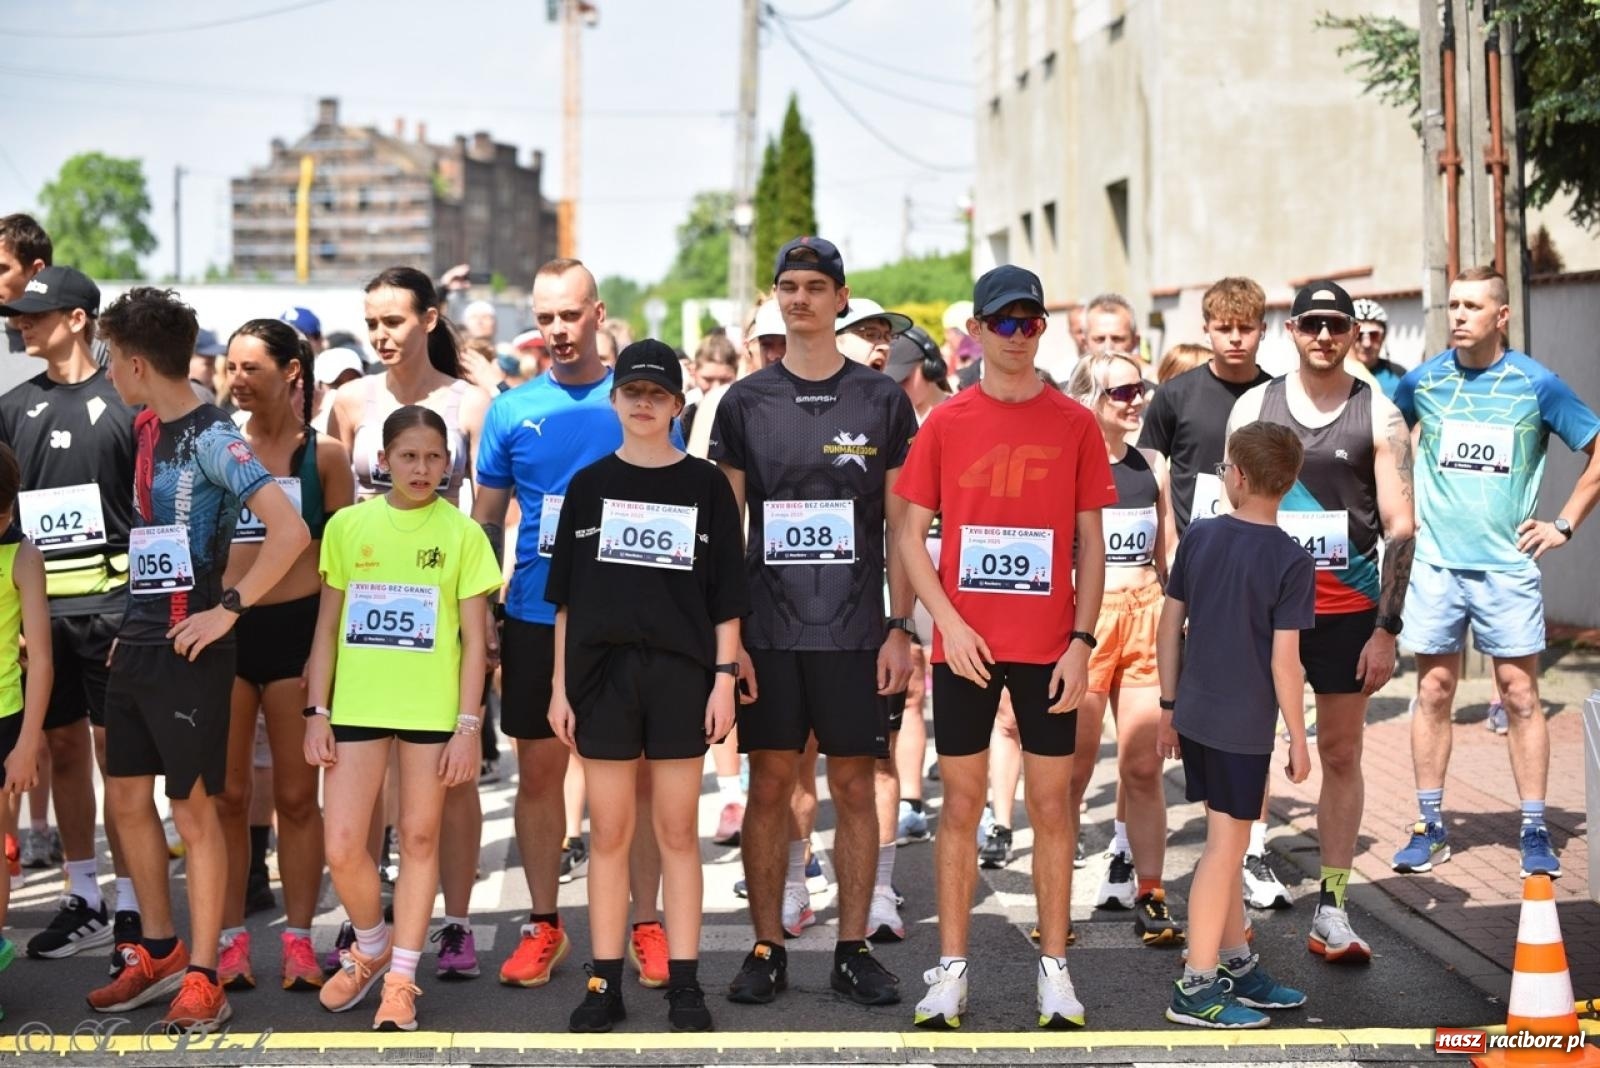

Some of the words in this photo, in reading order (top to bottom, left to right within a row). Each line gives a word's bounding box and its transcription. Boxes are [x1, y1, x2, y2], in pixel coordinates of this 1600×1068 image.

[1457, 442, 1495, 461] 020
[958, 443, 1063, 498] 4F
[39, 511, 83, 533] 042
[622, 526, 674, 551] 066
[786, 526, 833, 547] 038
[1109, 532, 1147, 550] 040
[138, 553, 173, 575] 056
[982, 553, 1030, 576] 039
[403, 586, 433, 594] GRANIC
[367, 608, 415, 632] 055
